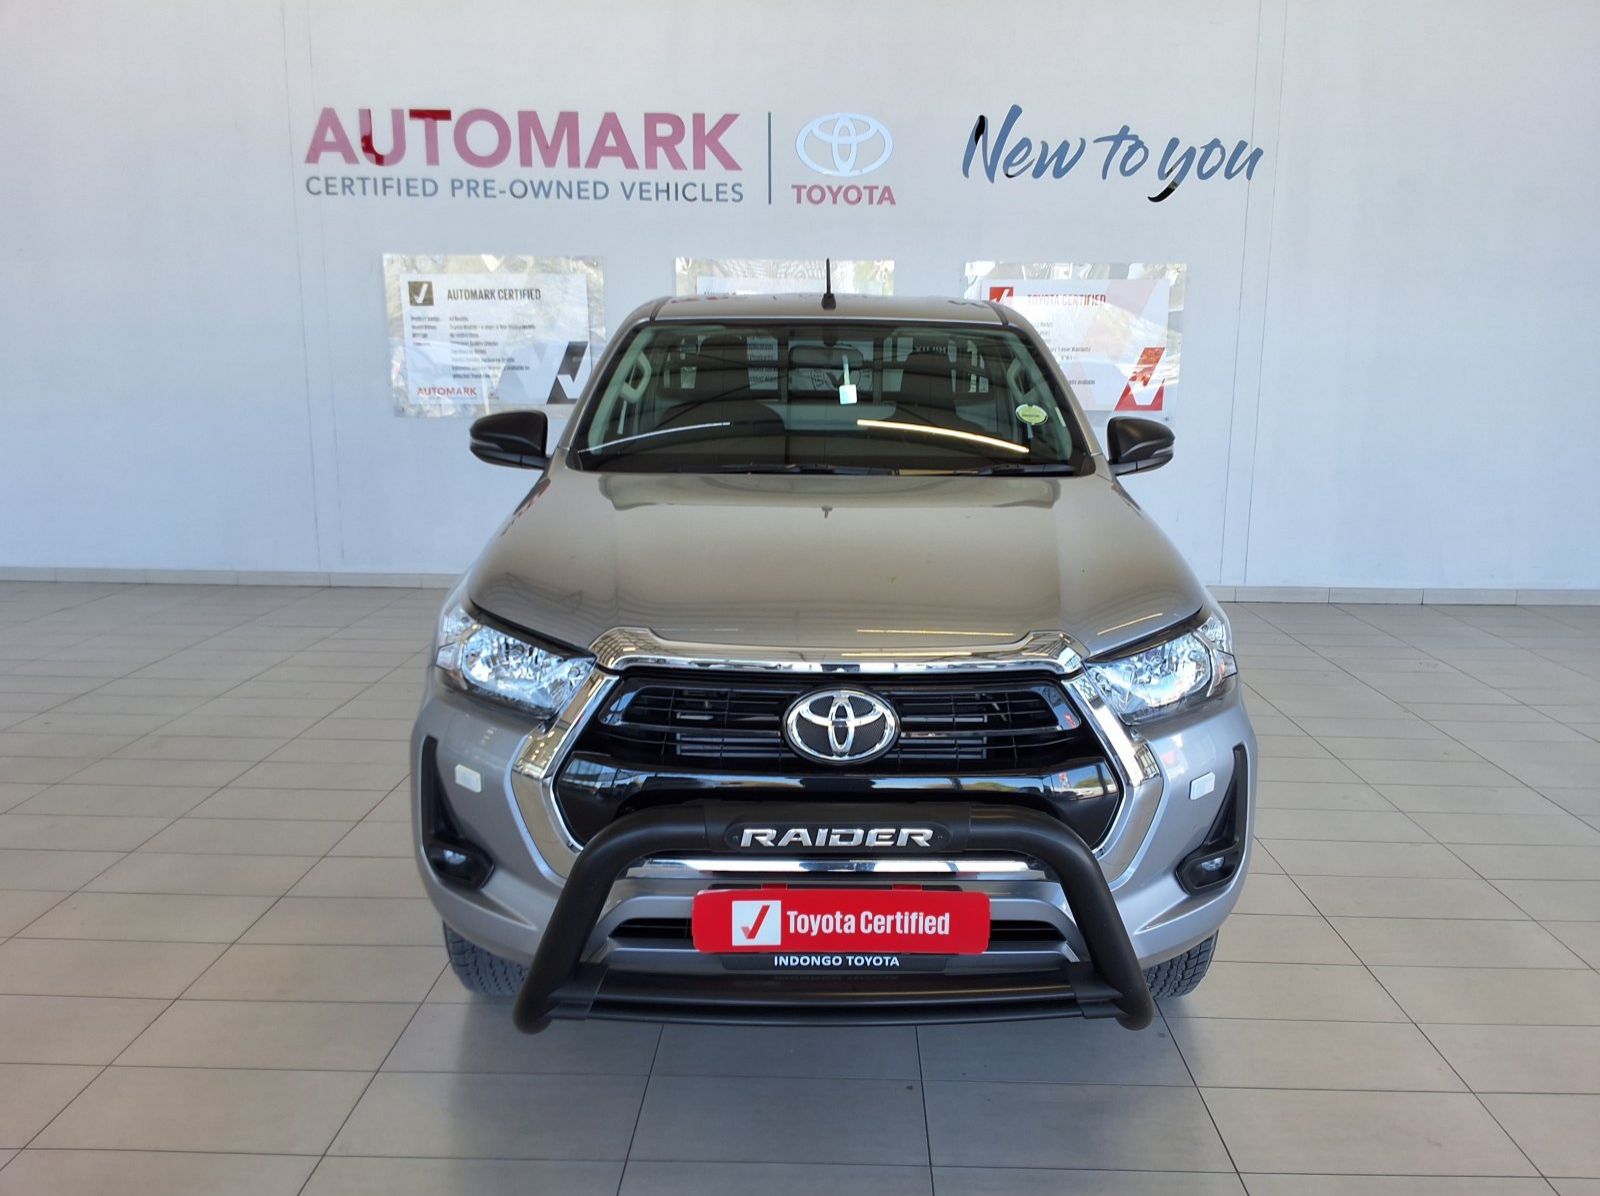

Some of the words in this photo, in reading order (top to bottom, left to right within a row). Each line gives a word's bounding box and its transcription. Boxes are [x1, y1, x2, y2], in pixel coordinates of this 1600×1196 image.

[305, 107, 742, 171] AUTOMARK
[962, 104, 1086, 183] New
[1093, 124, 1150, 180] to
[1147, 136, 1265, 203] you
[305, 176, 439, 197] CERTIFIED
[450, 179, 610, 201] PRE-OWNED
[621, 181, 744, 203] VEHICLES
[791, 184, 896, 206] TOYOTA
[447, 288, 496, 301] AUTOMARK
[497, 288, 541, 301] CERTIFIED
[1027, 294, 1059, 306] TOYOTA
[417, 387, 477, 396] AUTOMARK
[740, 827, 934, 848] RAIDER
[786, 910, 857, 936] Toyota
[860, 911, 951, 935] Certified
[773, 955, 843, 967] INDONGO
[846, 956, 900, 967] TOYOTA
